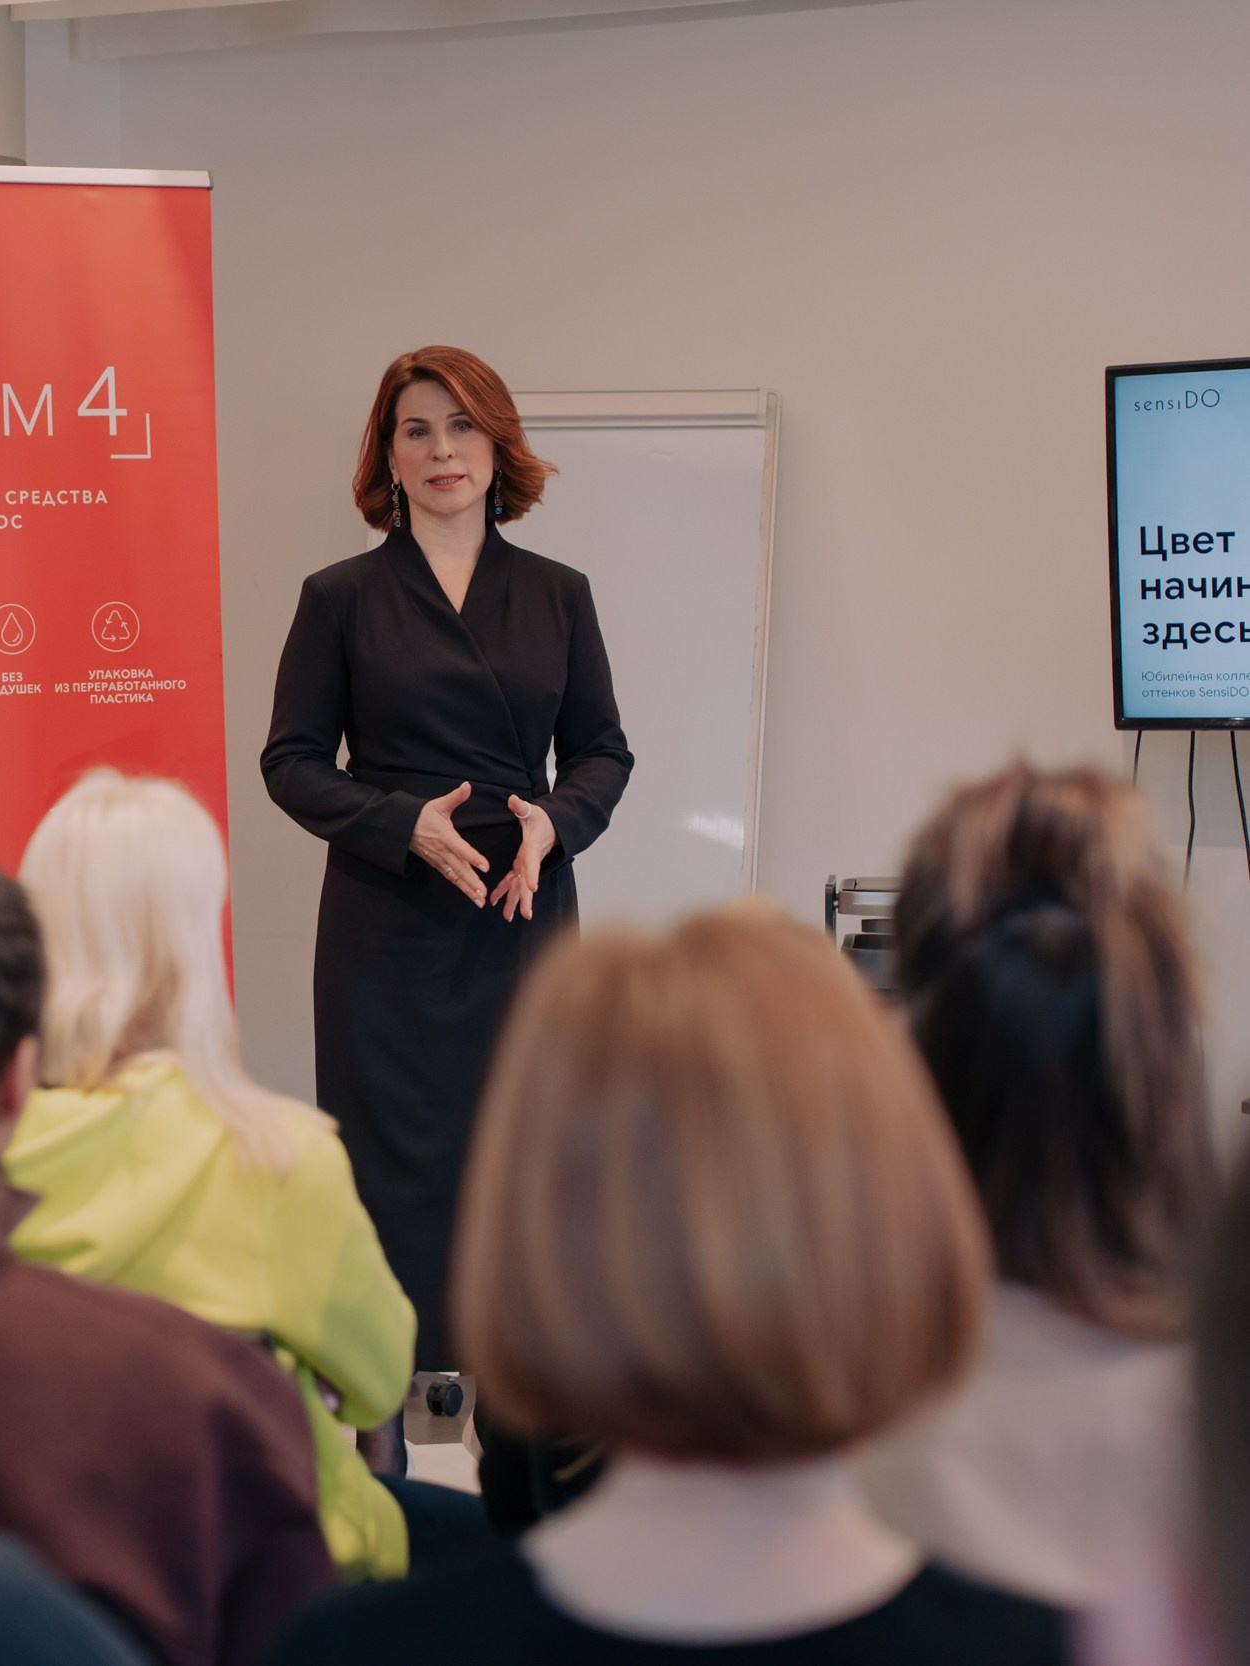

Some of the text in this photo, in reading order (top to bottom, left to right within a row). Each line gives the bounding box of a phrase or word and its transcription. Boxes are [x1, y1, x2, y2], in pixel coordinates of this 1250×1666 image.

[77, 366, 128, 436] 4
[5, 489, 108, 506] СРЕДСТВА
[1140, 525, 1235, 561] Цвет
[1140, 576, 1250, 600] начин
[1, 671, 23, 682] БЕЗ
[88, 669, 154, 680] УПАКОВКА
[1141, 670, 1213, 682] Юбилейная
[54, 680, 187, 693] ИЗ ПЕРЕРАБОТАННОГО
[1141, 686, 1249, 698] оттенков SensiDO
[89, 693, 154, 704] ПЛАСТИКА
